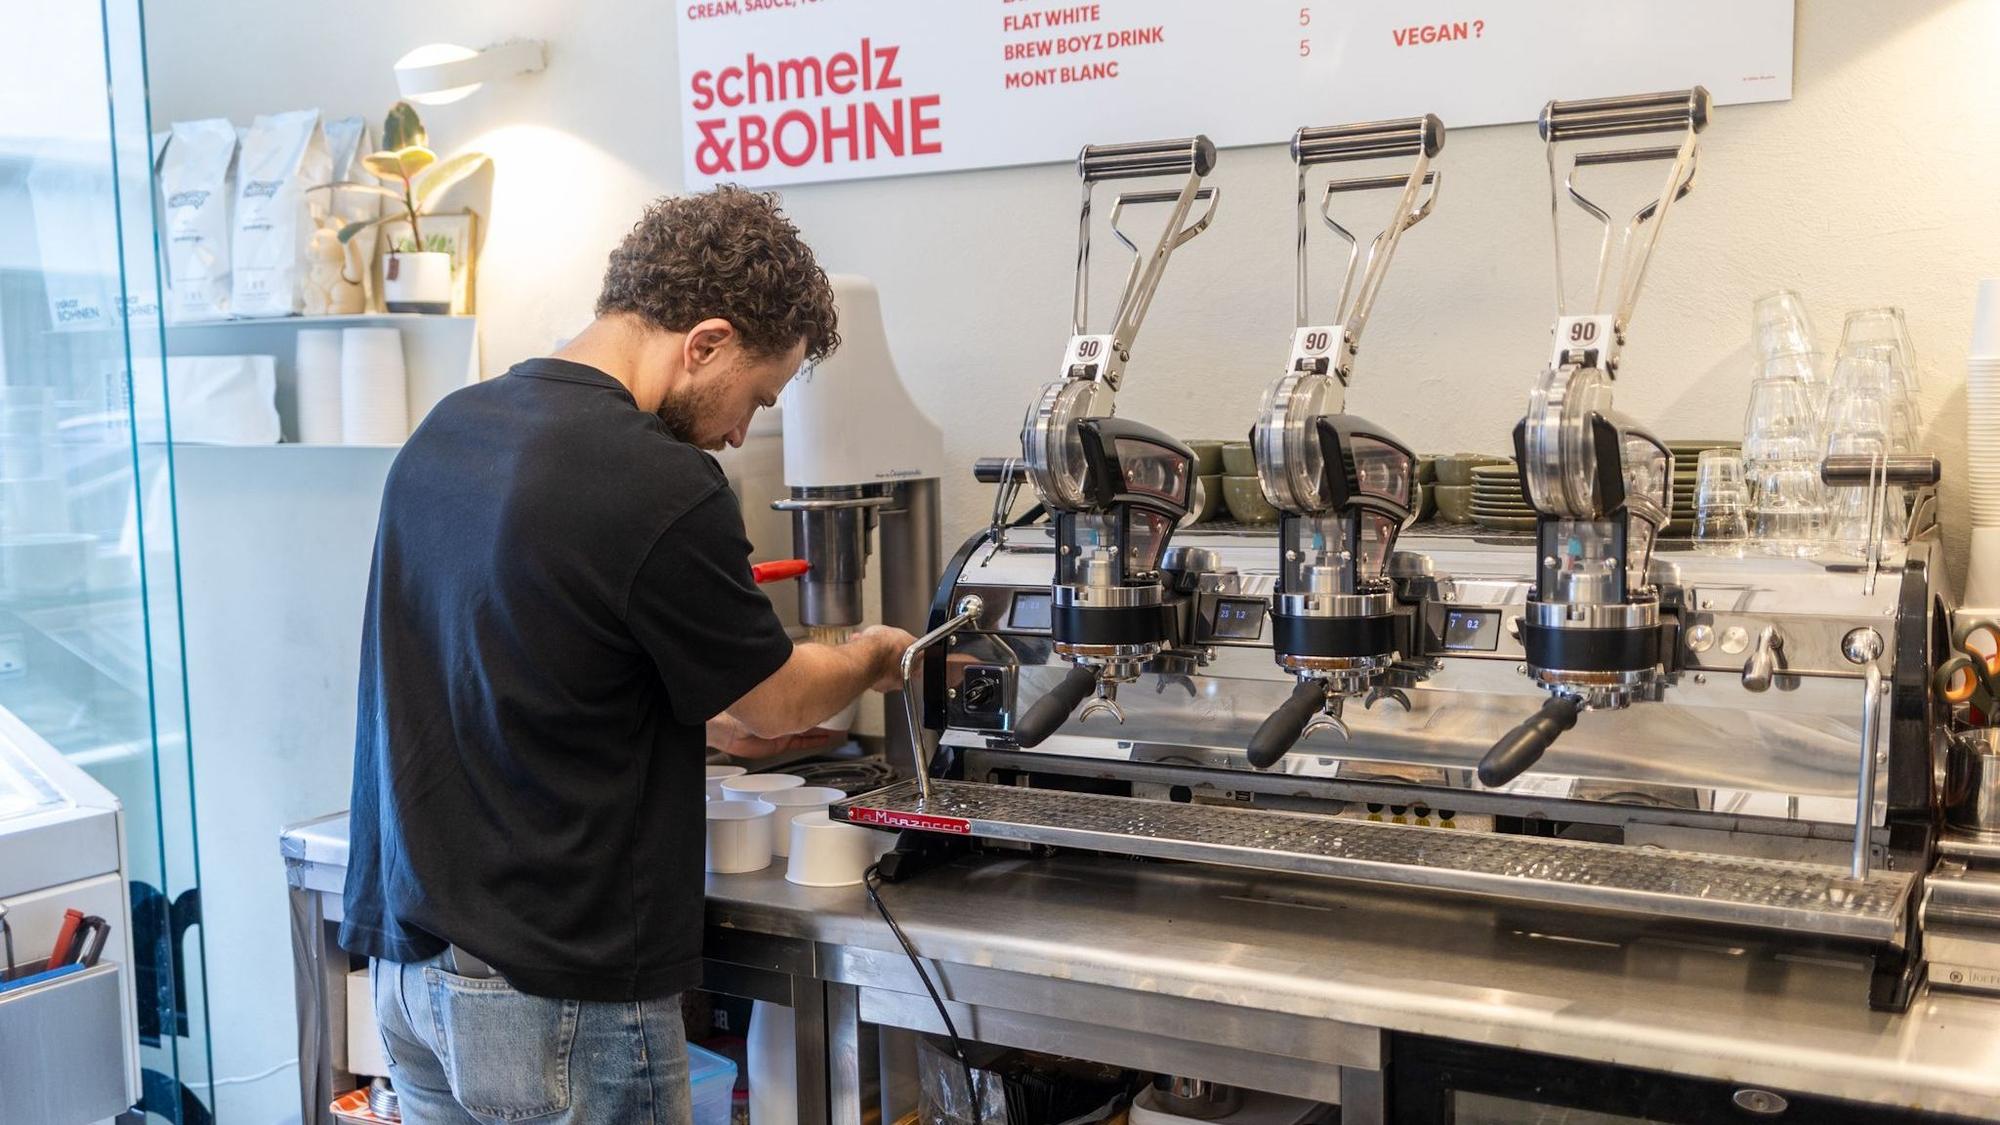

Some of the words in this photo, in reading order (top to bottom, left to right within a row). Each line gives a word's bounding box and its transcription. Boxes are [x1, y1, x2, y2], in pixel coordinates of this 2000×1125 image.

[687, 0, 741, 20] CREAM,
[1003, 12, 1041, 32] FLAT
[1045, 4, 1100, 27] WHITE
[1299, 7, 1311, 27] 5
[1004, 39, 1053, 61] BREW
[1057, 33, 1103, 55] BOYZ
[1107, 26, 1164, 49] DRINK
[1392, 21, 1468, 48] VEGAN
[1473, 18, 1486, 39] ?
[1299, 38, 1311, 57] 5
[690, 37, 902, 112] schmelz
[1005, 69, 1057, 89] MONT
[1060, 62, 1119, 84] BLANC
[695, 94, 943, 176] &BOHNE
[1304, 332, 1329, 351] 90
[1570, 321, 1597, 342] 90
[1077, 340, 1100, 358] 90
